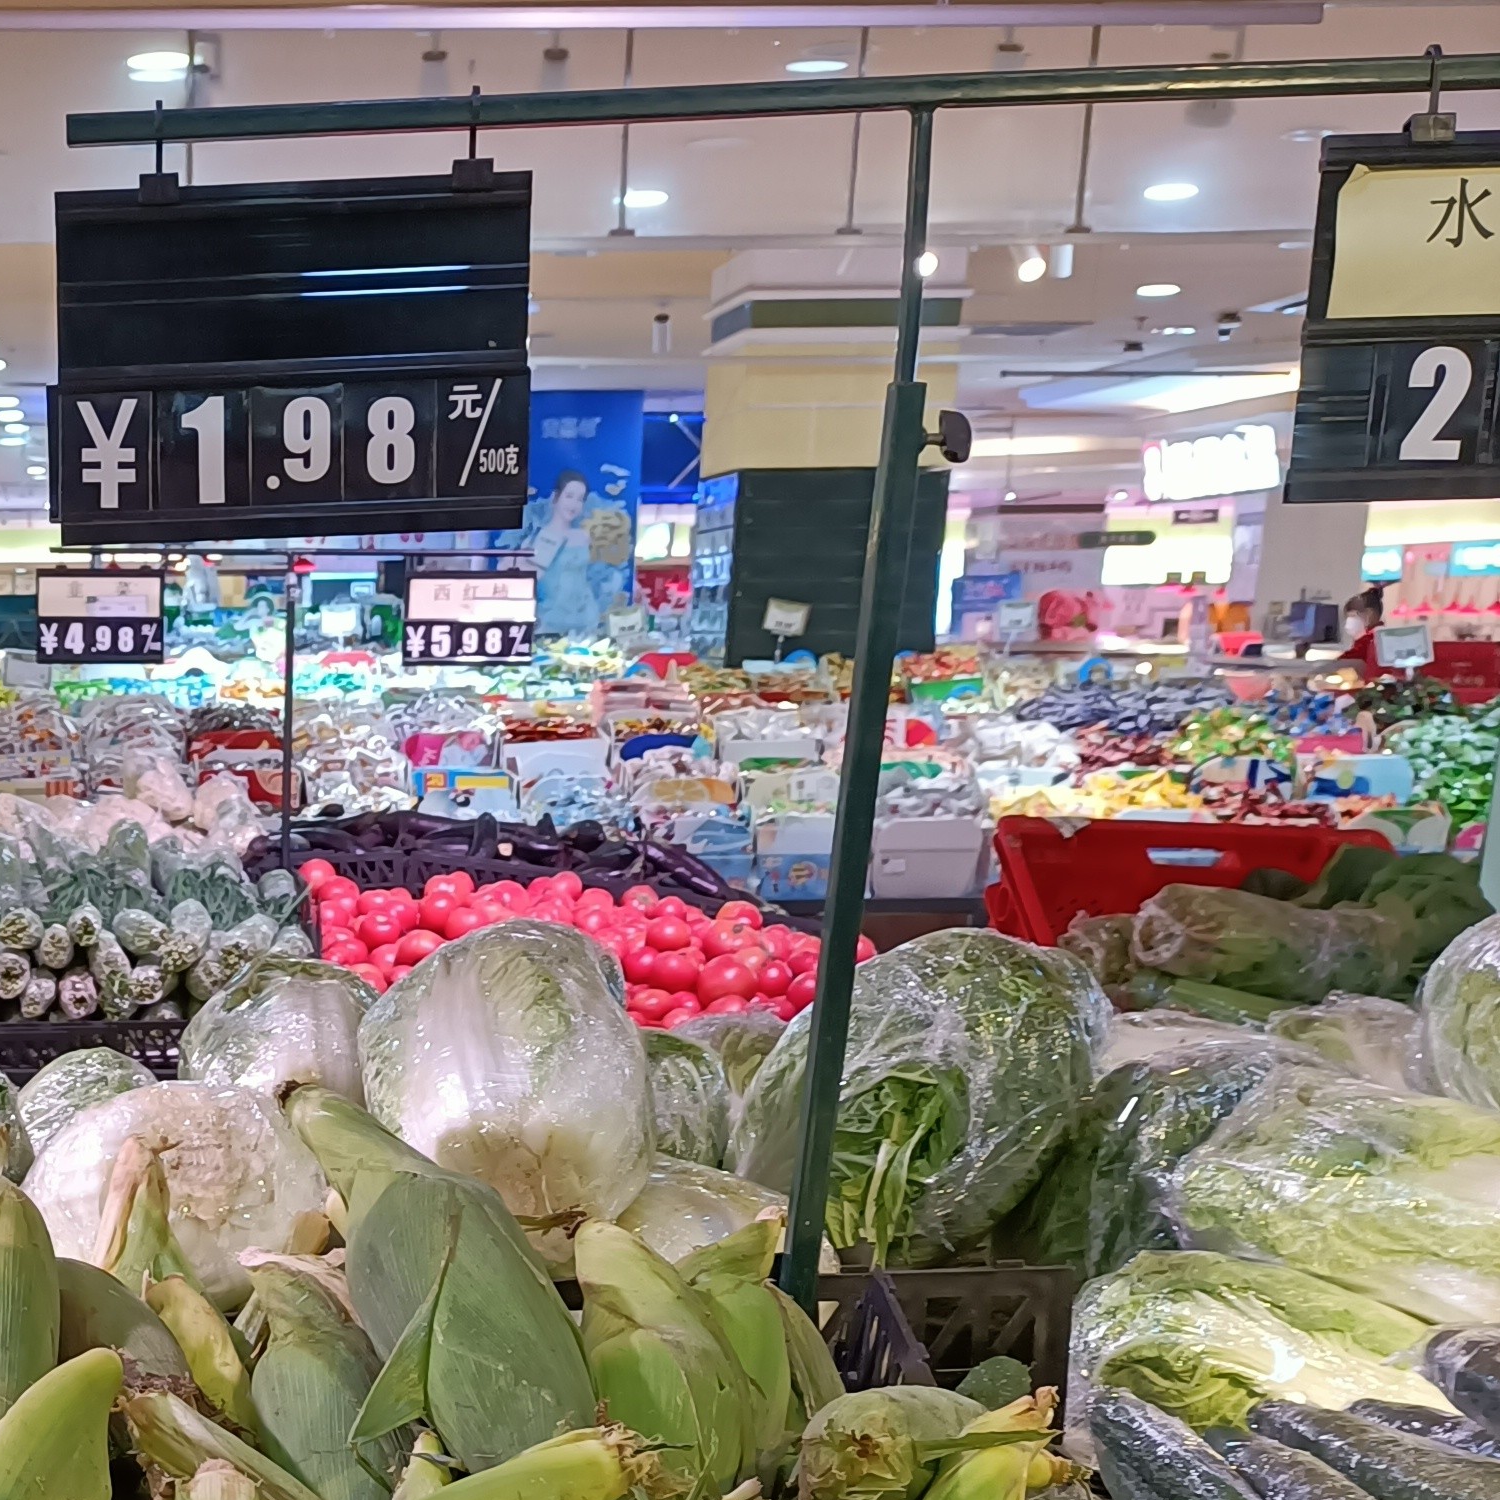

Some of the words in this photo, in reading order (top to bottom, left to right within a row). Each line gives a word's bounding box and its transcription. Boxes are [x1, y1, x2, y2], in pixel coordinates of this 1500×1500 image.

[1426, 178, 1494, 247] 水
[76, 396, 415, 508] ¥1.98
[1399, 346, 1472, 460] 2
